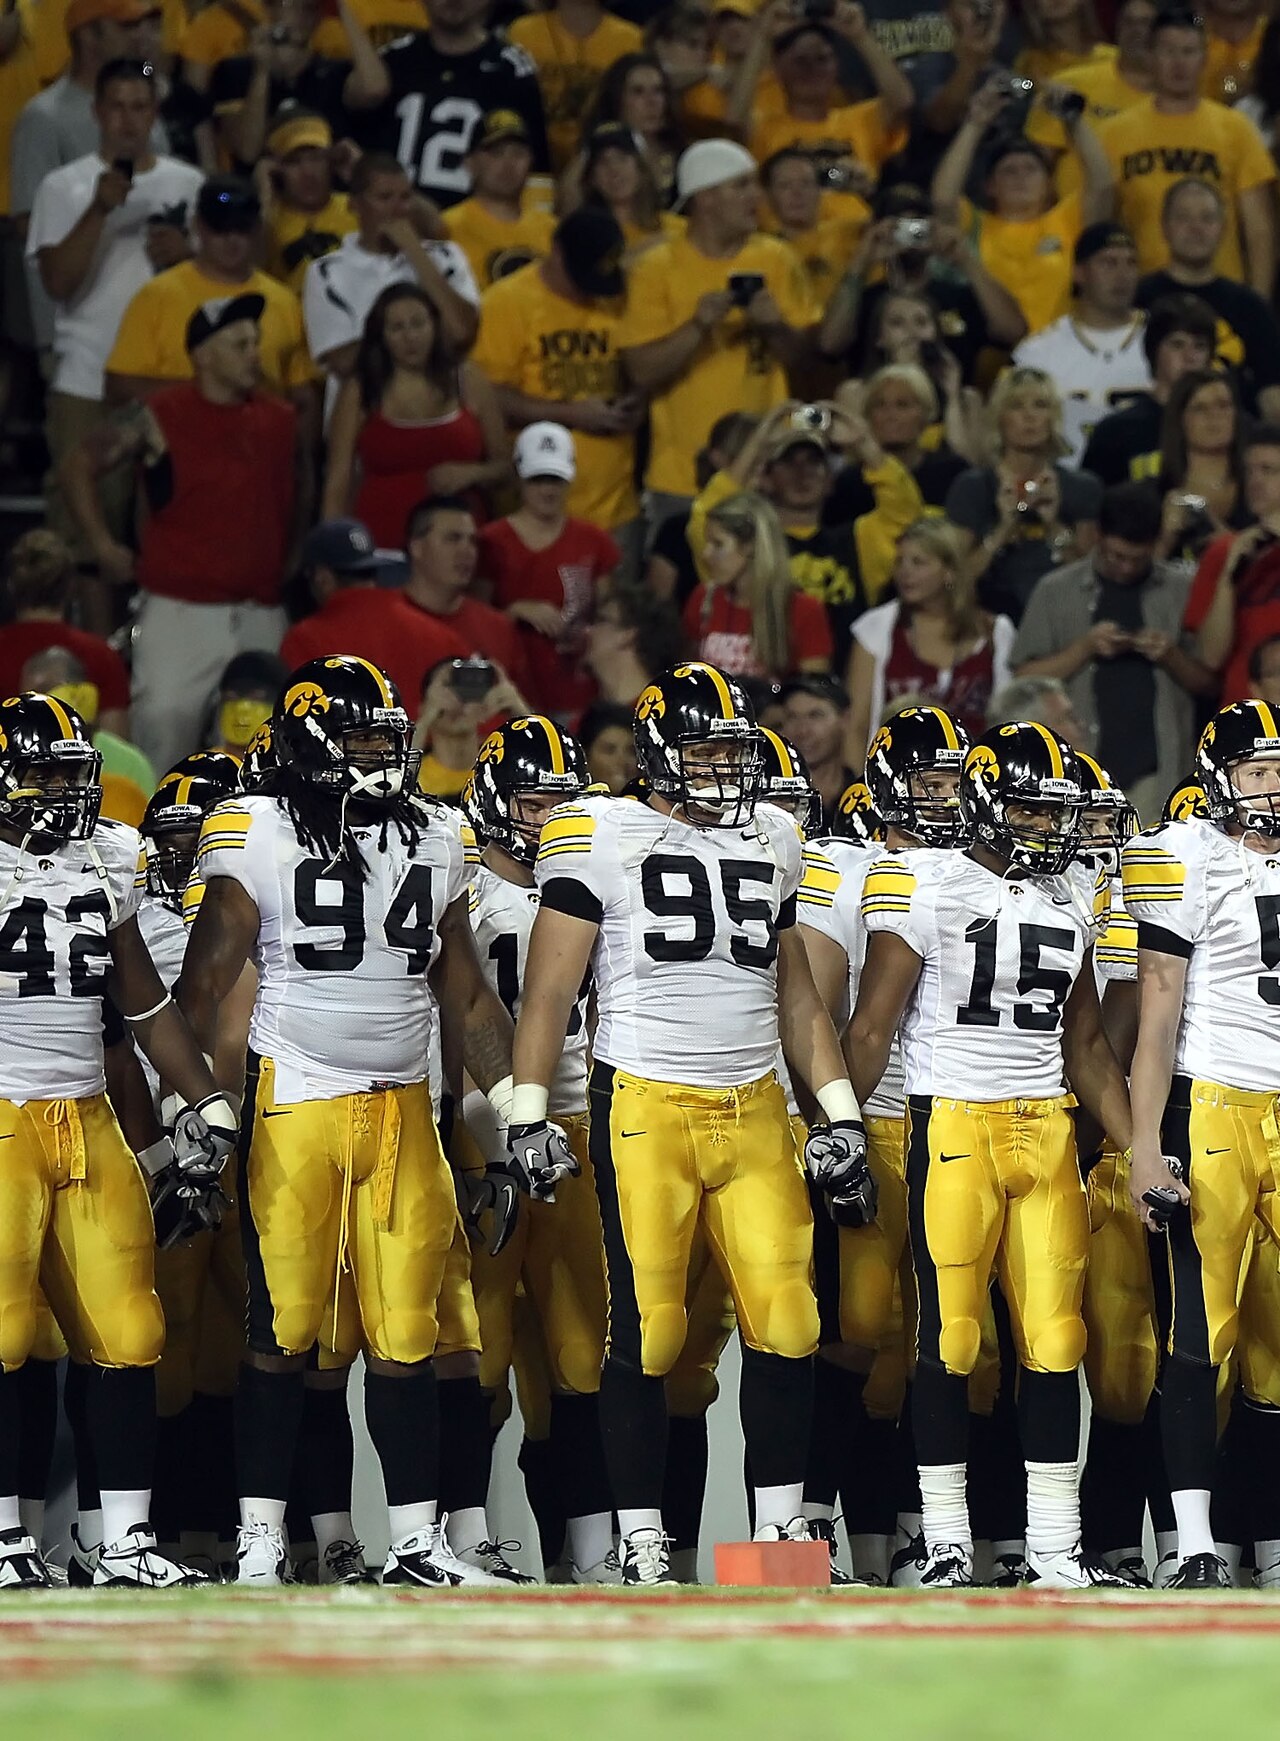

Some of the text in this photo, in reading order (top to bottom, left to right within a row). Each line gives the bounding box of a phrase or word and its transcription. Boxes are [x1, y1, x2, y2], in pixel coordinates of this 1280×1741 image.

[395, 92, 483, 193] 12
[1121, 147, 1221, 180] IOWA
[722, 720, 739, 728] IOWA
[62, 741, 80, 749] IOWA
[947, 750, 964, 759] IOWA
[550, 775, 568, 783] IOWA
[782, 779, 797, 787] IOWA
[1051, 781, 1068, 789] IOWA
[294, 858, 434, 975] 94
[641, 854, 779, 969] 95
[0, 890, 107, 997] 42
[956, 918, 1076, 1031] 15
